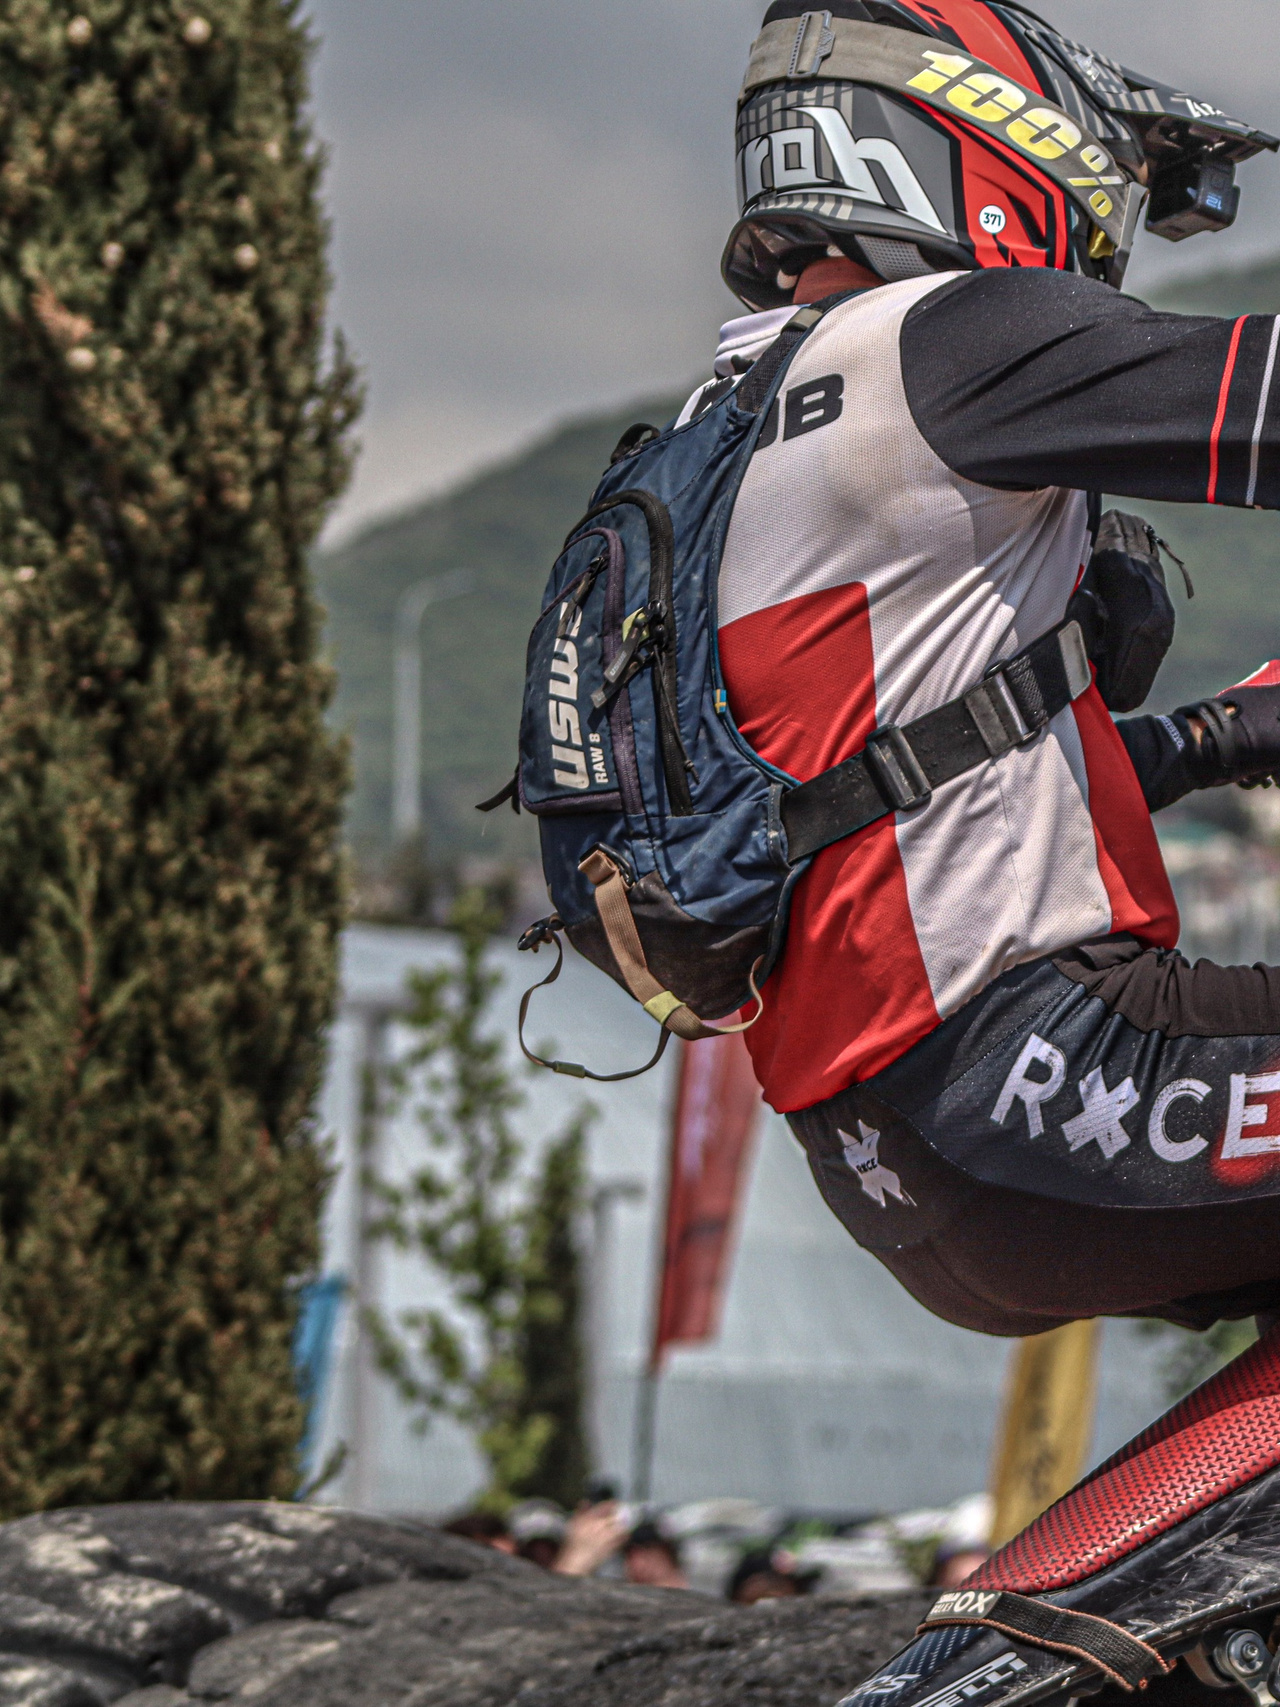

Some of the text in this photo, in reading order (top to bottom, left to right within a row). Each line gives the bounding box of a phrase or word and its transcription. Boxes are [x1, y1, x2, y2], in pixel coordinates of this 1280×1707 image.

[906, 50, 1124, 218] 100%
[983, 212, 1001, 227] 371
[589, 733, 608, 784] RAW 8
